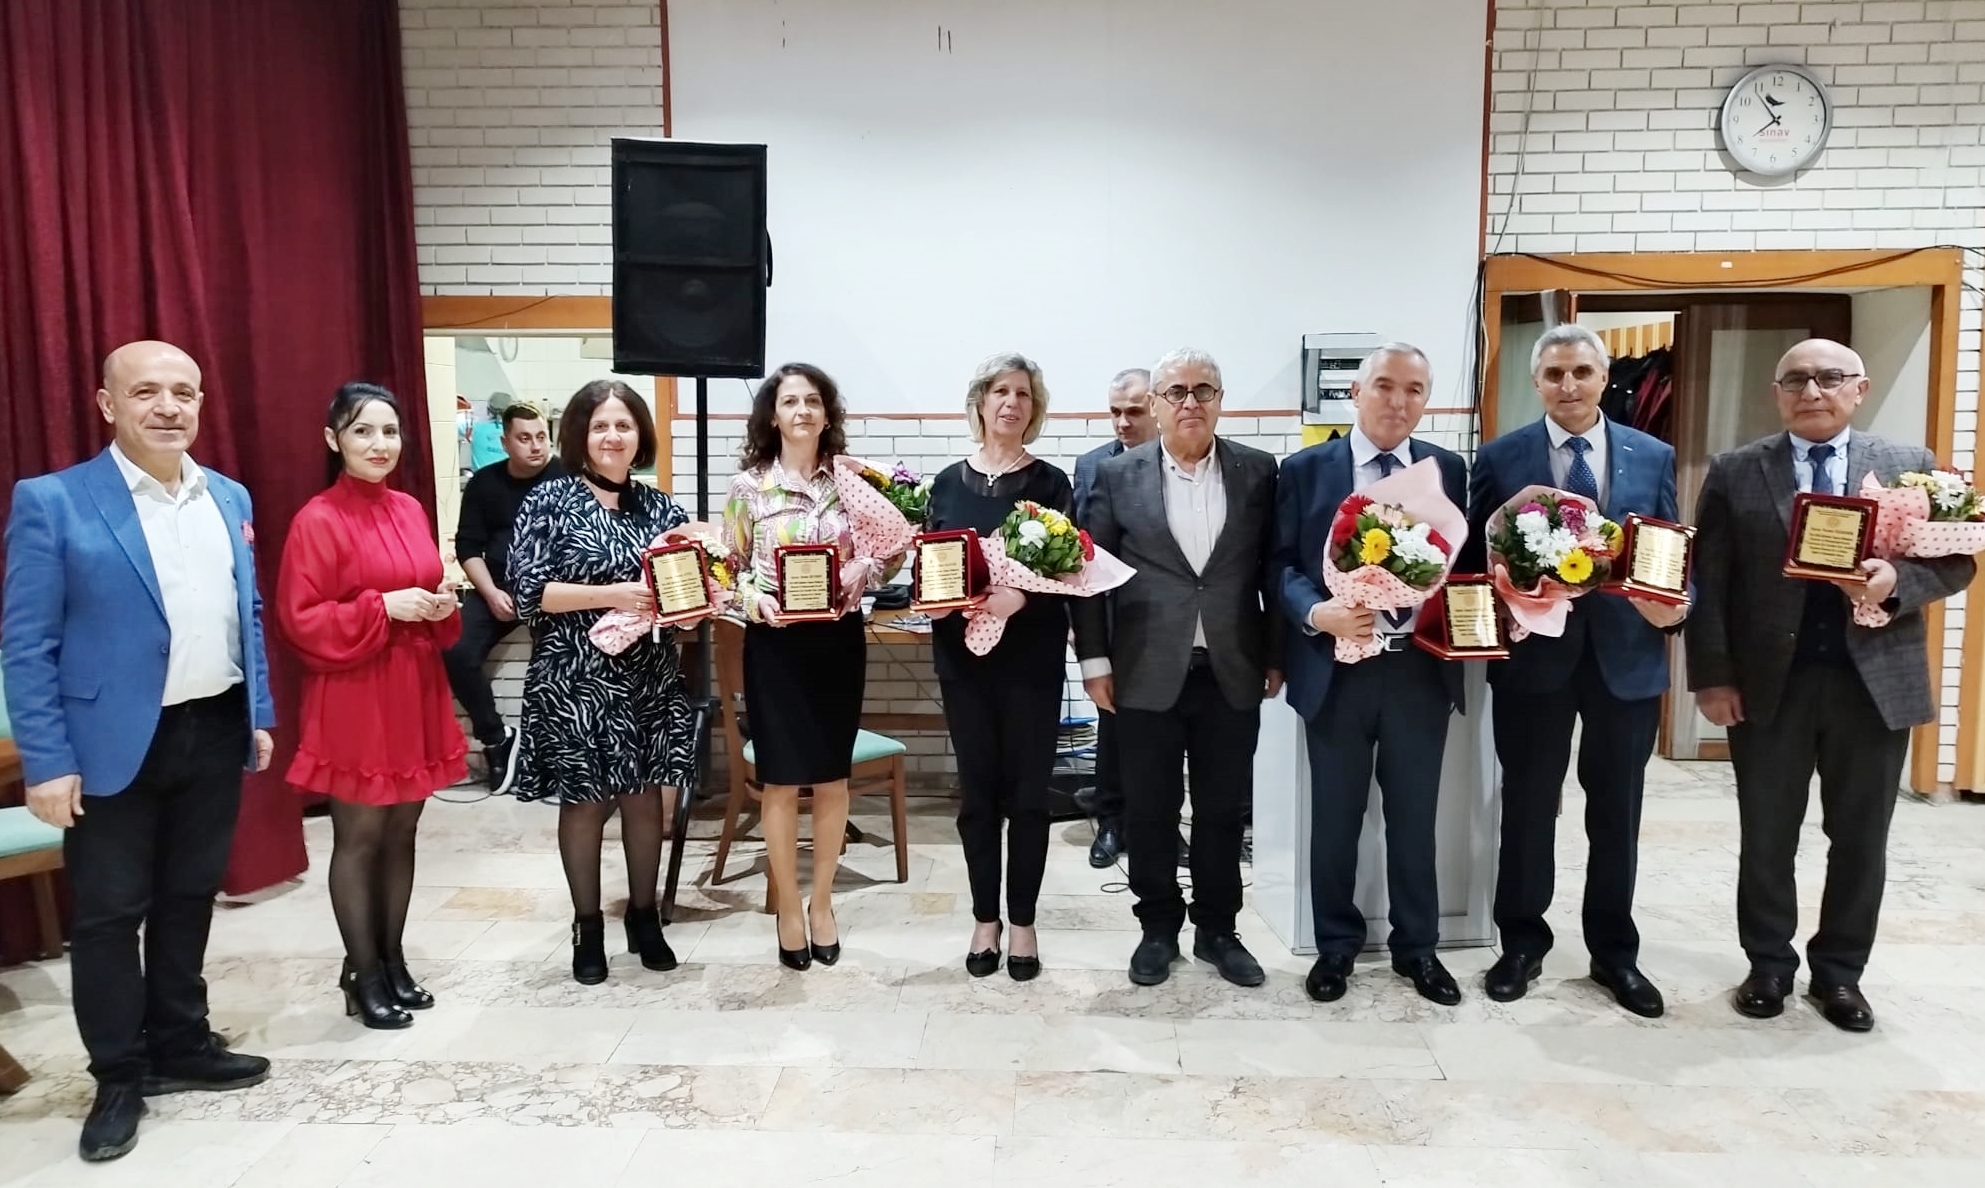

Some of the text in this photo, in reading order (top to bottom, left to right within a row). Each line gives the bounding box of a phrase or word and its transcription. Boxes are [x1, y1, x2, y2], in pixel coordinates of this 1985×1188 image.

[1773, 76, 1784, 87] 12
[1754, 82, 1764, 92] 11
[1740, 96, 1751, 107] 10
[1808, 96, 1815, 107] 2
[1733, 115, 1739, 124] 9
[1813, 114, 1818, 125] 3
[1738, 135, 1743, 144] 8
[1805, 134, 1811, 143] 4
[1751, 147, 1757, 157] 7
[1791, 147, 1798, 157] 5
[1770, 154, 1776, 163] 6
